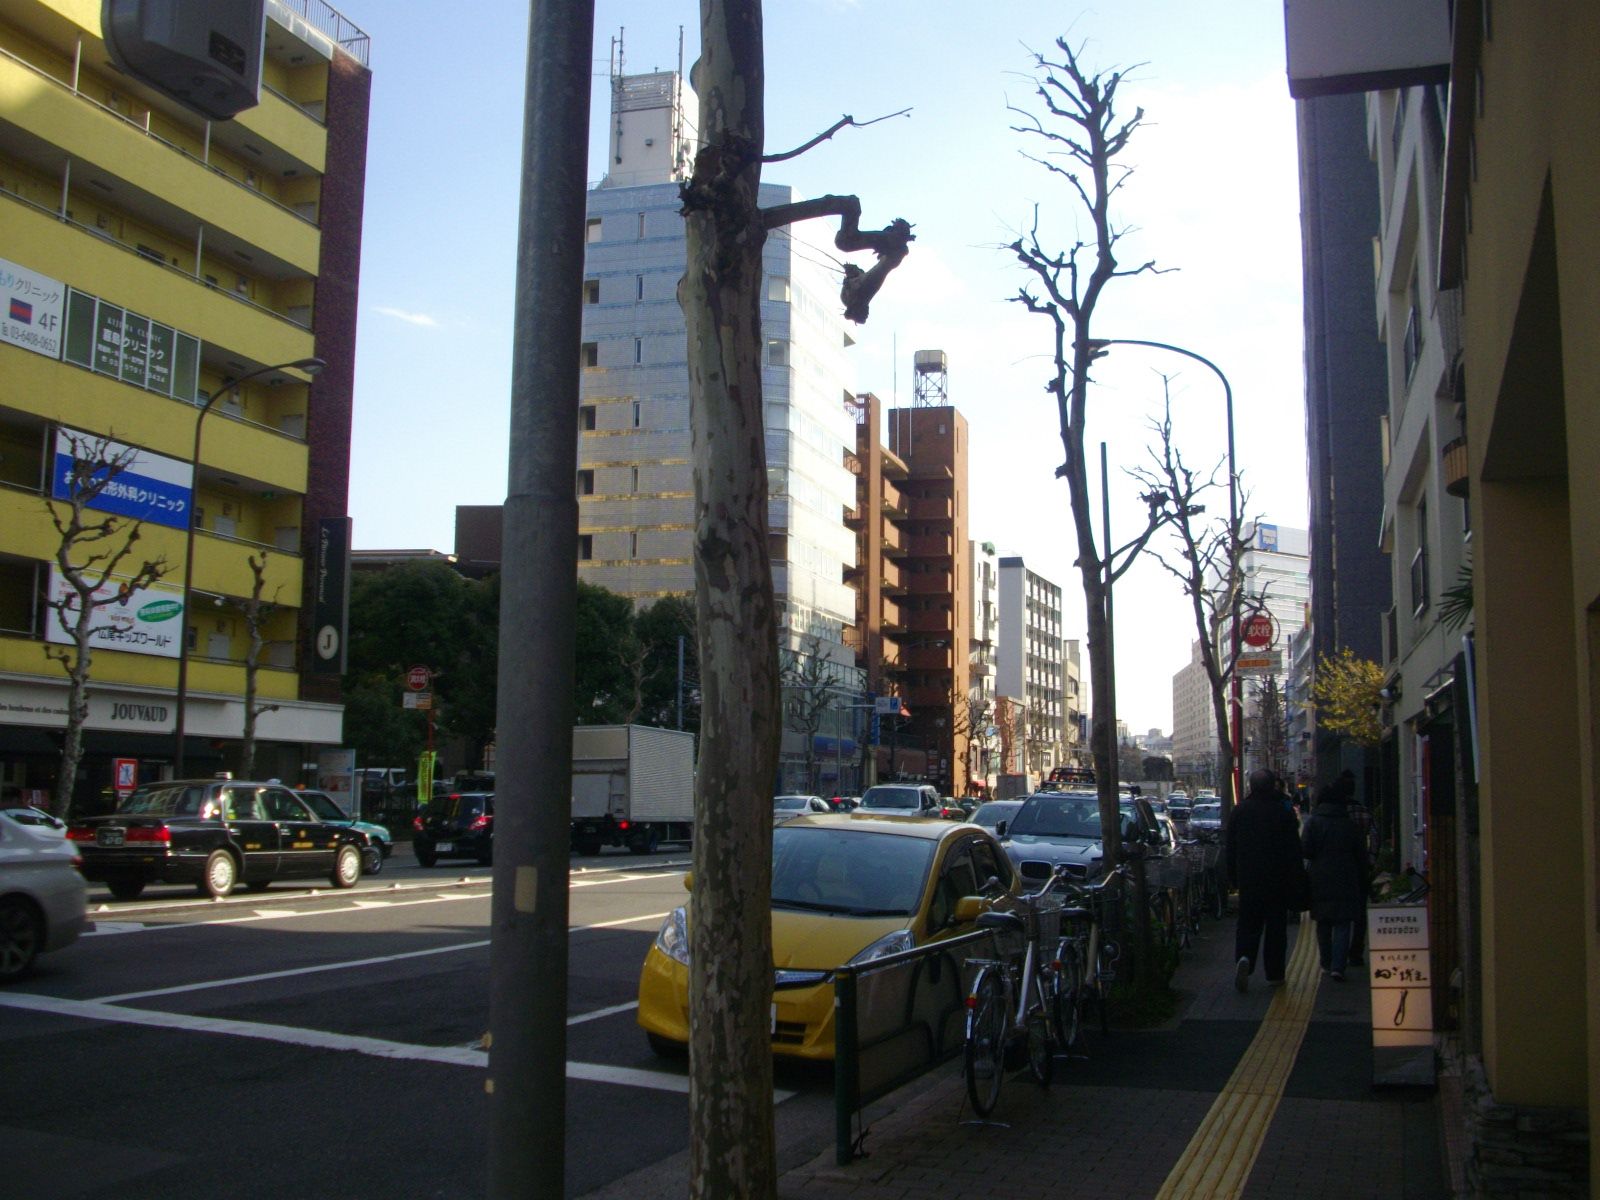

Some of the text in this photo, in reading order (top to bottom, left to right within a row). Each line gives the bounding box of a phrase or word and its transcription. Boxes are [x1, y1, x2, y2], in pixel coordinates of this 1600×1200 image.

[38, 310, 57, 332] 4F
[323, 634, 331, 650] J
[111, 702, 168, 722] JOUVAUD
